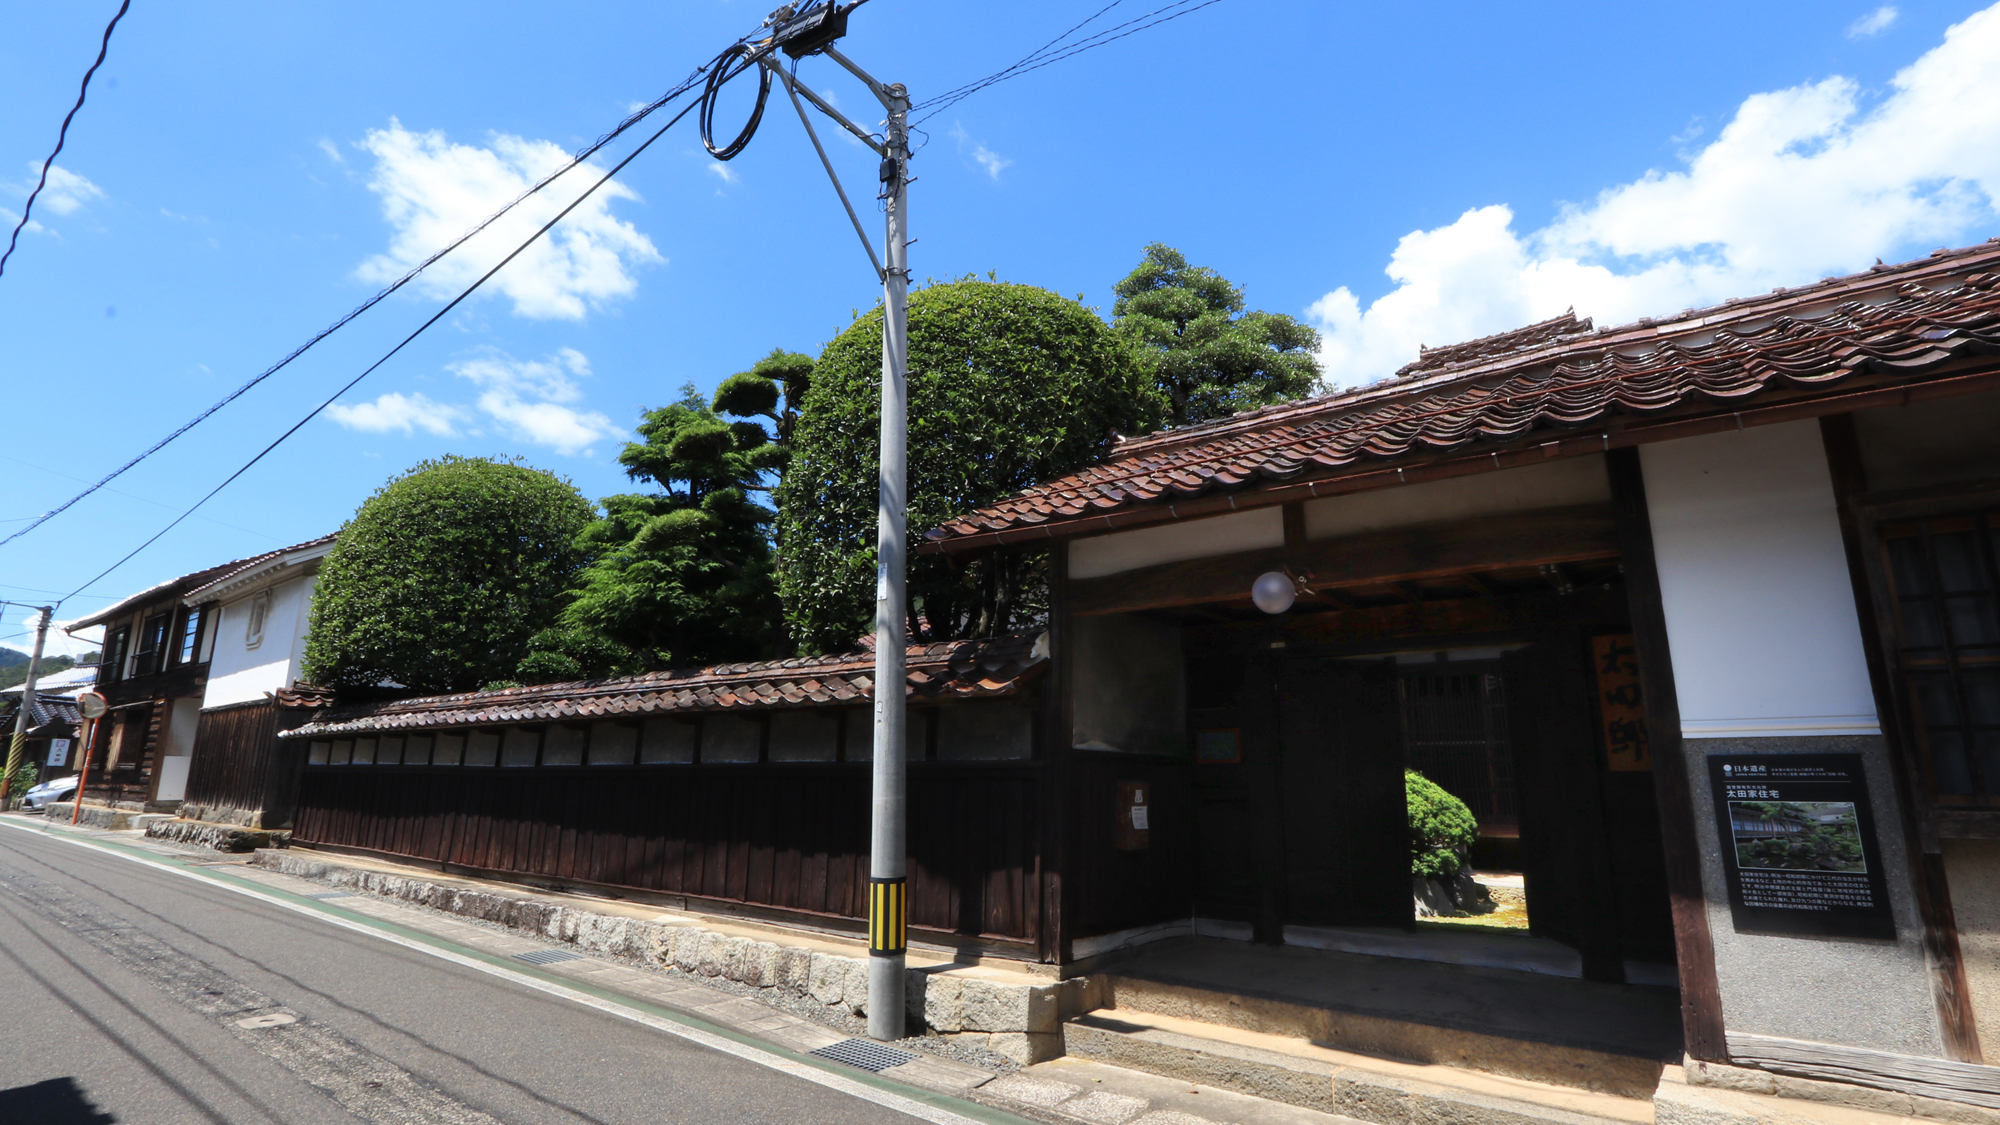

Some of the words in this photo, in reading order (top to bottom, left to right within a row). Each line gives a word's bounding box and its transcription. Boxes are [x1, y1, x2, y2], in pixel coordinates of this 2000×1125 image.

[1726, 790, 1780, 798] 太田家住宅
